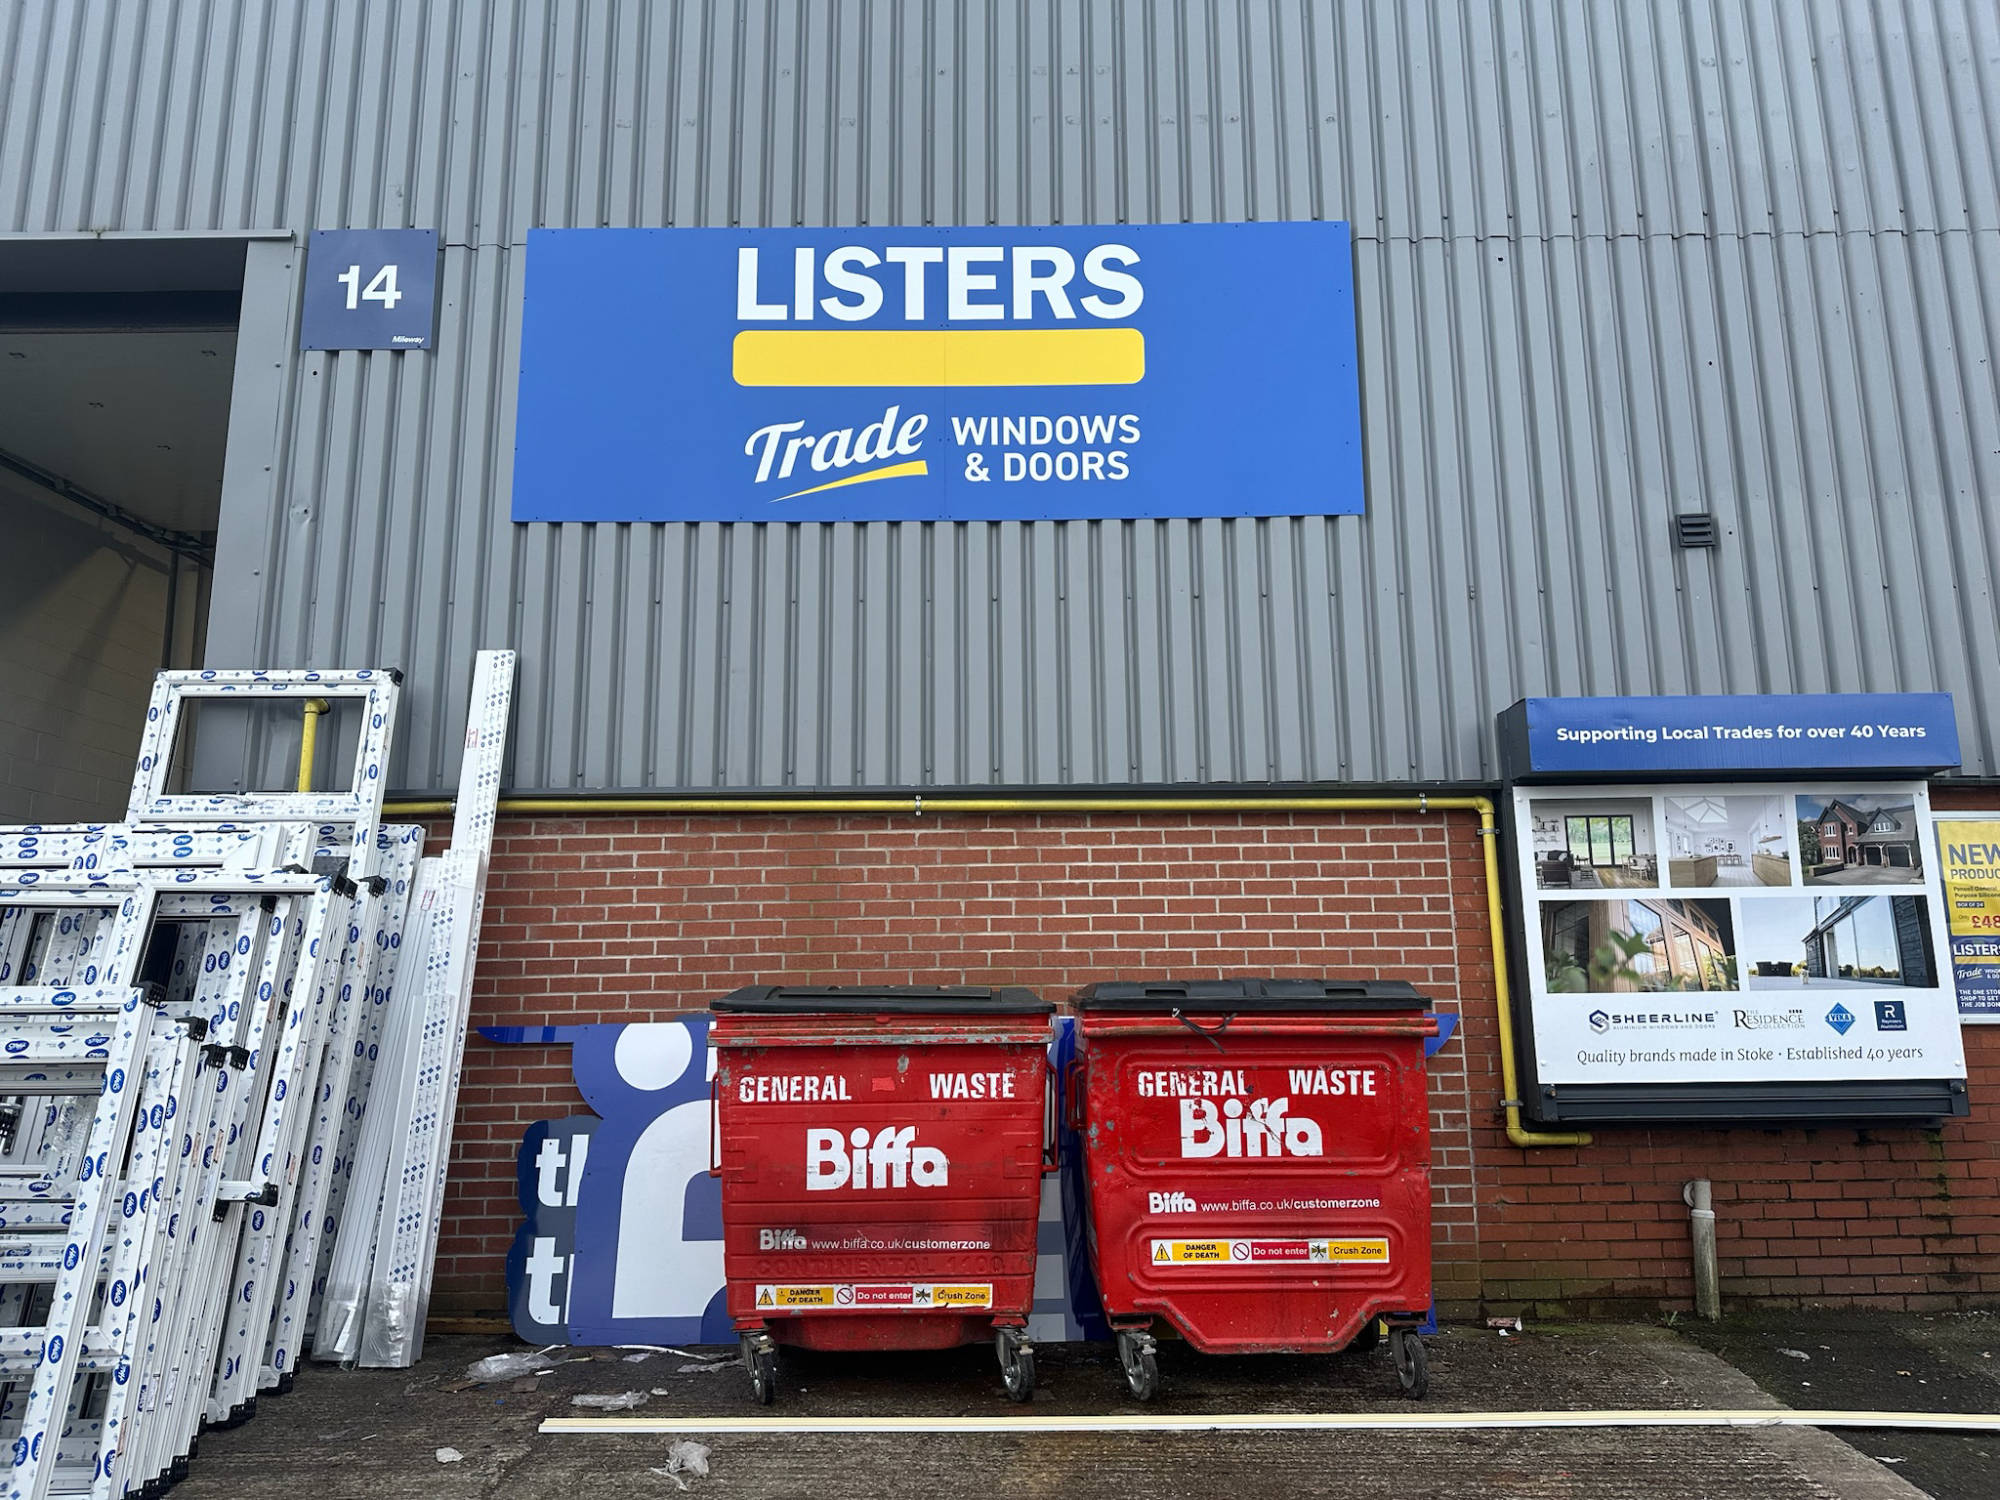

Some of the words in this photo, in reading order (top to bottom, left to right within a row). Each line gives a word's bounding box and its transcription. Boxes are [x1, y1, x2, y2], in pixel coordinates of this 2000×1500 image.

[338, 265, 402, 310] 14
[737, 244, 1144, 321] LISTERS
[951, 414, 1141, 446] WINDOWS
[744, 405, 929, 484] Trade
[964, 452, 991, 482] &
[1004, 451, 1129, 482] DOORS
[1556, 726, 1657, 744] Supporting
[1662, 725, 1709, 740] Local
[1713, 726, 1773, 740] Trades
[1776, 725, 1802, 739] for
[1807, 727, 1846, 738] over
[1850, 726, 1874, 738] 40
[1877, 725, 1927, 738] Years
[1948, 843, 2000, 866] NEW
[1957, 967, 1983, 979] Trade
[1612, 1013, 1715, 1024] SHEERLINE
[1732, 1010, 1805, 1029] RESIDENCE
[1577, 1050, 1626, 1067] Quality
[1630, 1049, 1676, 1063] brands
[1679, 1048, 1717, 1062] made
[1721, 1048, 1734, 1061] in
[1737, 1047, 1774, 1061] Stoke
[1787, 1046, 1863, 1060] Established
[1866, 1048, 1883, 1062] 40
[1887, 1047, 1924, 1062] years
[739, 1075, 852, 1103] GENERAL
[929, 1073, 1017, 1099] WASTE
[1138, 1070, 1249, 1097] GENERAL
[1288, 1070, 1376, 1097] WASTE
[1180, 1097, 1324, 1158] Biffa
[806, 1126, 949, 1191] Biffa
[1148, 1192, 1197, 1214] Biffa
[1201, 1197, 1380, 1213] www.biffa.co.uk/customerzone
[759, 1228, 807, 1250] Biffa
[811, 1238, 991, 1251] www.biffa.co.uk/customerzone
[1185, 1243, 1217, 1251] DANGER
[1195, 1251, 1220, 1259] DEATH
[1253, 1247, 1266, 1256] Do
[1268, 1247, 1283, 1256] not
[1333, 1246, 1358, 1255] Crush
[1361, 1246, 1382, 1255] Zone
[787, 1296, 798, 1304] OF
[789, 1288, 821, 1296] DANGER
[857, 1291, 870, 1300] Do
[872, 1292, 887, 1300] not
[888, 1292, 912, 1300] enter
[937, 1289, 963, 1300] Crush
[965, 1291, 986, 1300] Zone
